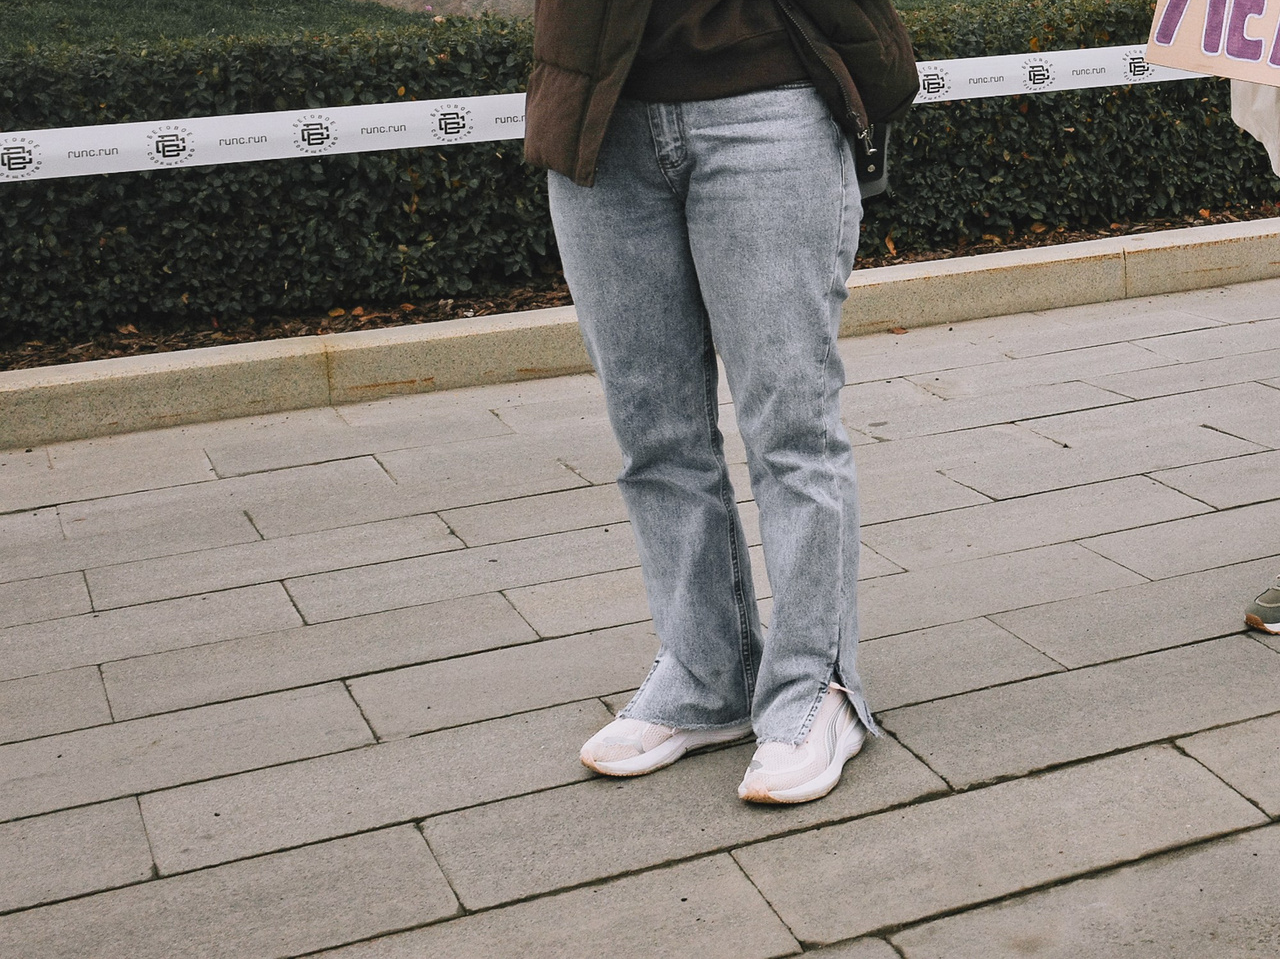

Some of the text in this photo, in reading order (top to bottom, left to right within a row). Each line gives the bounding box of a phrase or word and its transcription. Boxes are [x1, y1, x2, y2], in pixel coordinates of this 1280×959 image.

[1072, 67, 1106, 76] runc.run
[968, 75, 1005, 85] runc.run
[495, 115, 526, 124] runc.r
[360, 124, 407, 135] runc.run
[219, 135, 268, 146] runc.run
[67, 147, 119, 159] runc.run
